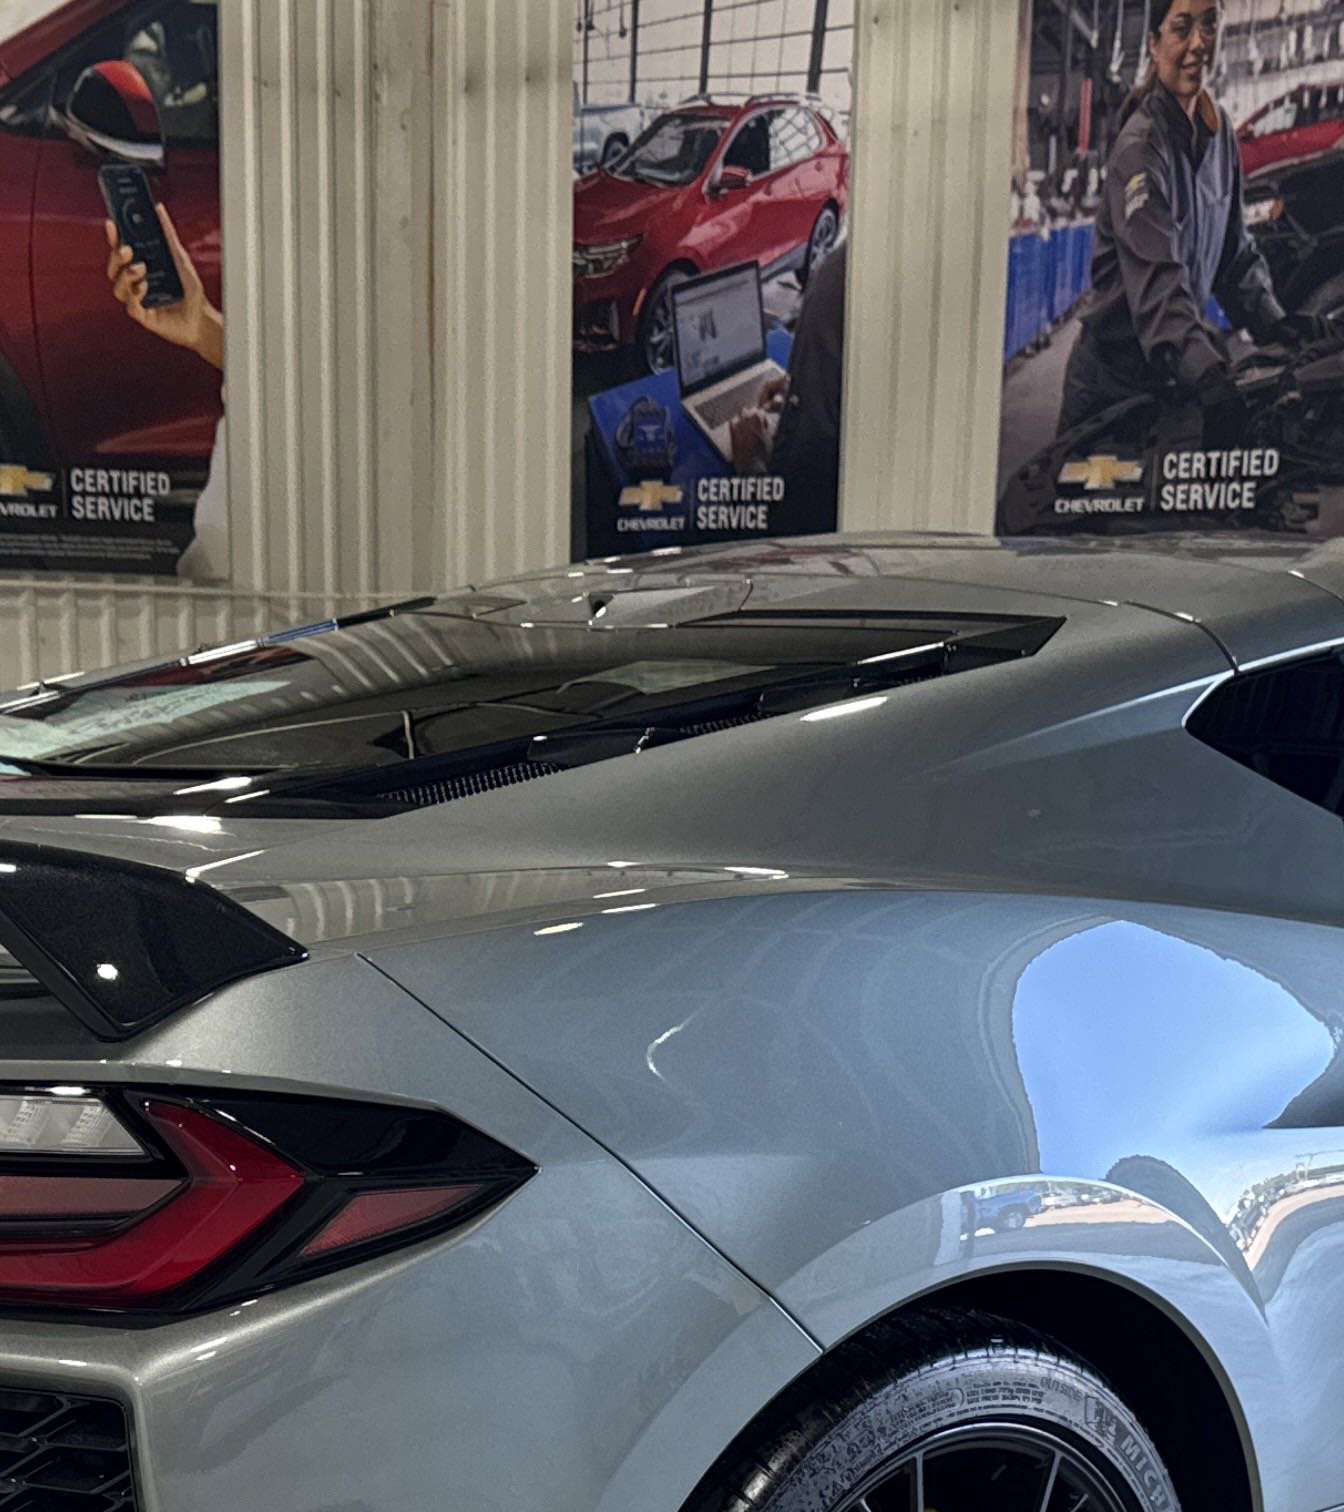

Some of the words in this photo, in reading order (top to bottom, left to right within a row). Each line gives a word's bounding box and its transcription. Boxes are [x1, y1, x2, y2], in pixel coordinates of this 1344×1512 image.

[1163, 449, 1280, 479] CERTIFIED
[70, 468, 171, 495] CERTIFIED
[697, 476, 785, 501] CERTIFIED
[71, 496, 156, 522] SERVICE
[1054, 497, 1144, 513] CHEVROLET
[1160, 482, 1257, 511] SERVICE
[617, 517, 686, 531] CHEVROLET
[697, 505, 769, 530] SERVICE
